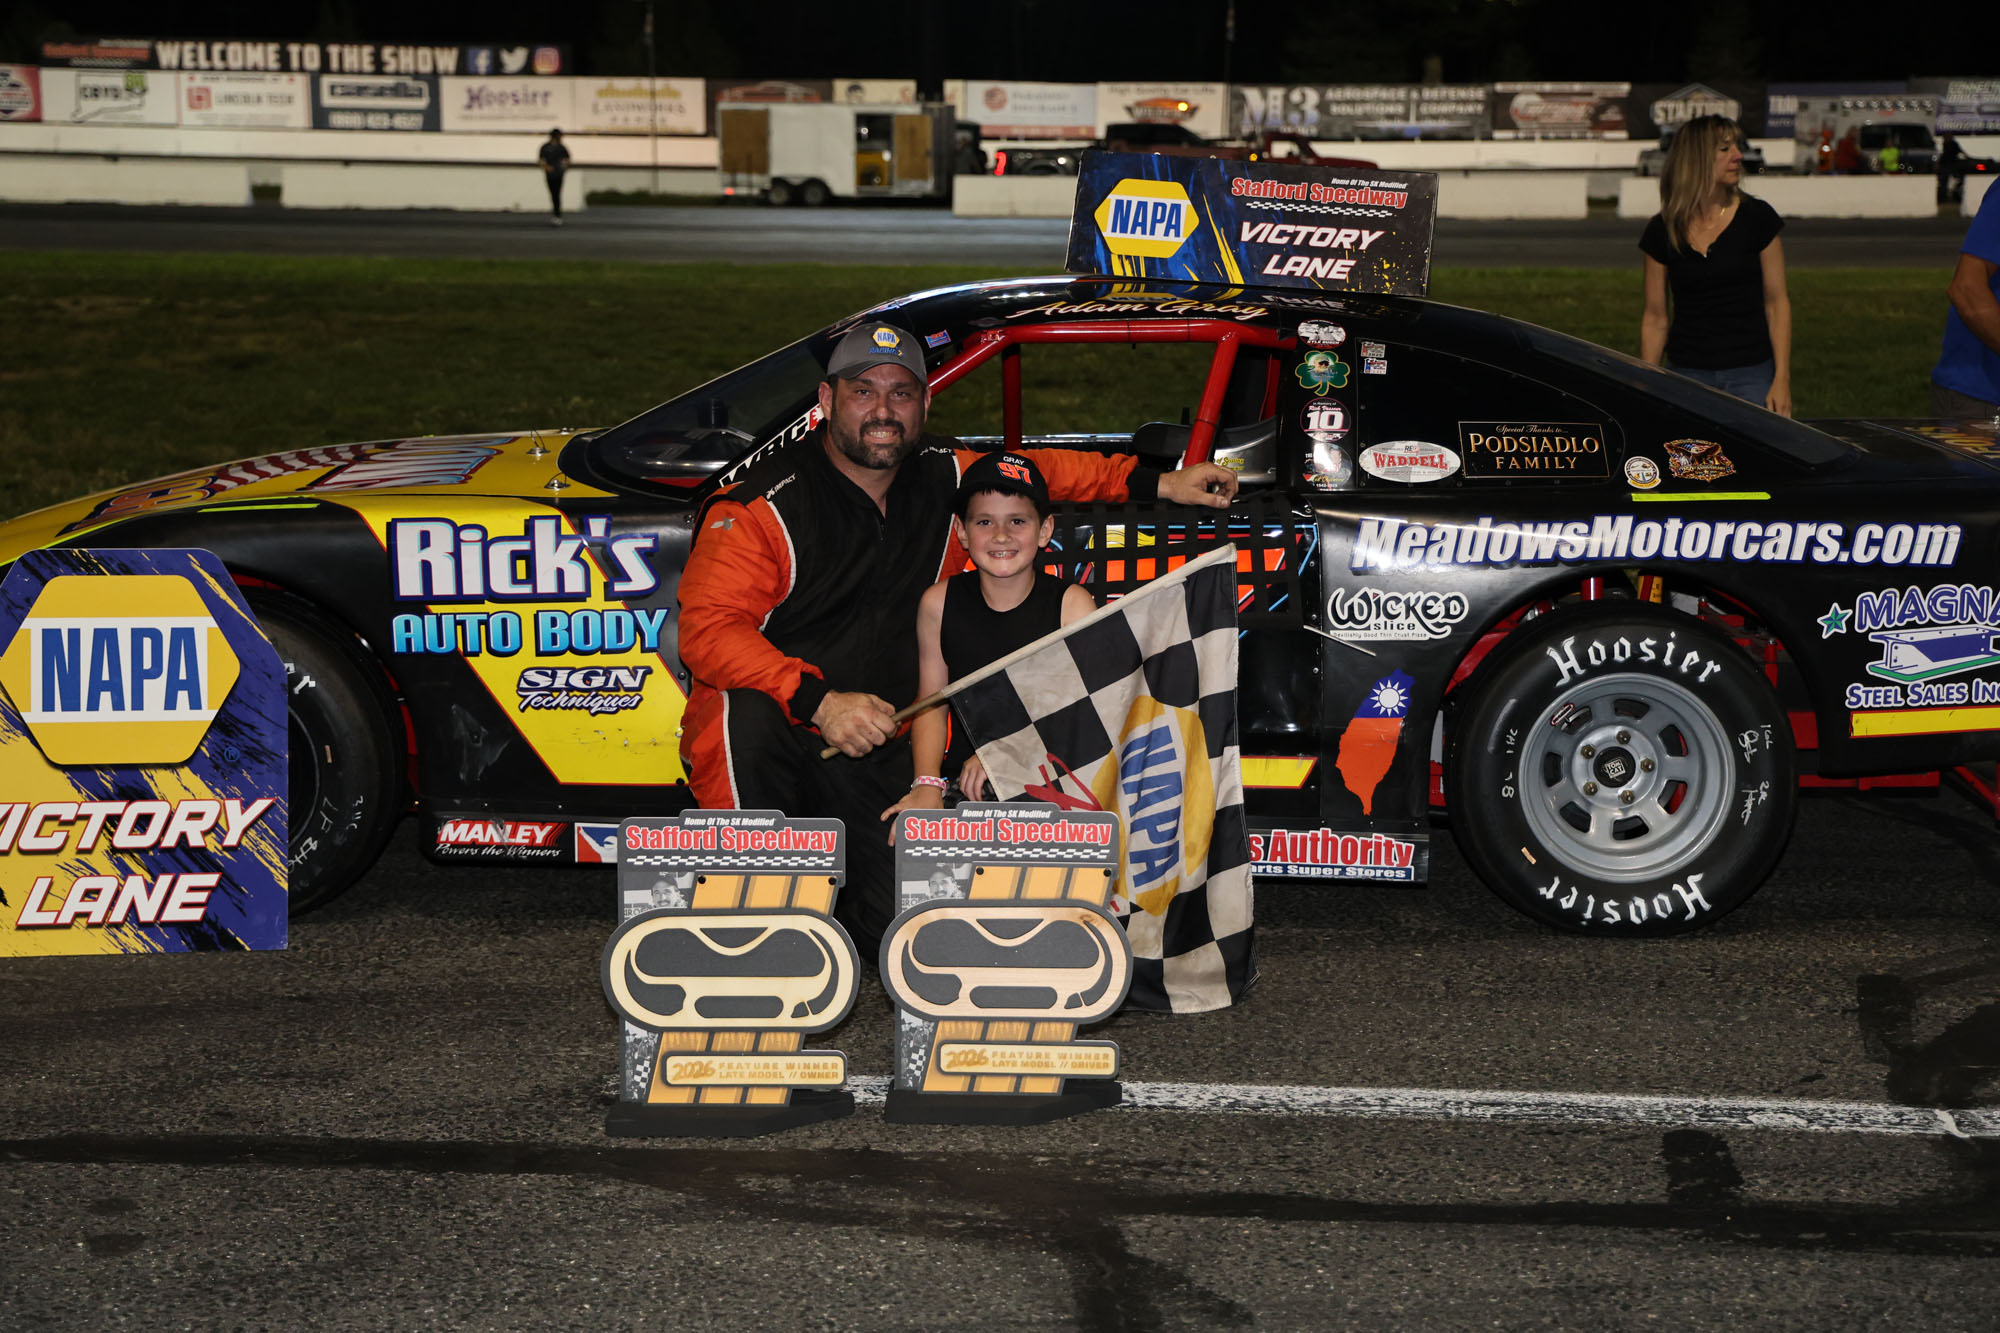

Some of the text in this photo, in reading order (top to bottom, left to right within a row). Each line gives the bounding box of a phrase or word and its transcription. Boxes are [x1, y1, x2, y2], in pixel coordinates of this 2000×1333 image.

[155, 41, 281, 70] WELCOME
[286, 43, 321, 71] TO
[327, 45, 375, 73] THE
[381, 45, 459, 74] SHOW
[1231, 177, 1408, 209] Stafford Speedway
[1331, 178, 1350, 186] Home
[1379, 181, 1407, 189] Modified
[1110, 199, 1183, 239] NAPA
[1239, 221, 1386, 250] VICTORY
[1262, 254, 1357, 280] LANE
[1005, 300, 1150, 319] Adam
[1154, 299, 1268, 320] Gray
[877, 331, 897, 344] NAPA
[1307, 410, 1344, 430] 10
[1495, 424, 1524, 435] Special
[1526, 424, 1554, 434] Thanks
[1468, 433, 1600, 453] PODSIADLO
[1003, 456, 1025, 466] GRAY
[1373, 451, 1449, 470] WADDELL
[1495, 456, 1577, 470] FAMILY
[996, 462, 1034, 487] 97
[1351, 514, 1964, 570] MeadowsMotorcars.com
[388, 515, 659, 601] Rick's
[391, 608, 671, 656] AUTO BODY
[1373, 621, 1416, 631] slice
[42, 627, 202, 712] NAPA
[1546, 631, 1721, 687] Hoosier
[517, 666, 652, 692] SIGN
[516, 690, 643, 715] Techniques
[1845, 683, 1905, 708] STEEL
[1907, 681, 1969, 706] SALES
[962, 809, 1051, 818] Home Of The SK Modified
[1121, 725, 1184, 889] NAPA
[684, 817, 775, 826] Home Of The SK Modified
[905, 817, 1112, 845] Stafford Speedway
[438, 822, 553, 845] MANLEY
[626, 825, 838, 853] Stafford Speedway
[435, 843, 563, 859] Powers the Winners
[1268, 828, 1415, 868] Authority
[1250, 864, 1407, 878] arts Super Stores
[16, 872, 223, 928] LANE
[1538, 873, 1712, 926] Hoosier
[719, 1062, 839, 1071] FEATURE WINNER
[944, 1049, 989, 1069] 2026
[992, 1051, 1110, 1061] FEATURE WINNER
[992, 1060, 1018, 1068] LATE
[1020, 1060, 1056, 1069] MODEL
[1071, 1060, 1110, 1070] DRIVER
[672, 1060, 717, 1081] 2026
[719, 1071, 746, 1079] LATE
[748, 1071, 785, 1079] MODEL
[800, 1071, 839, 1080] OWNER
